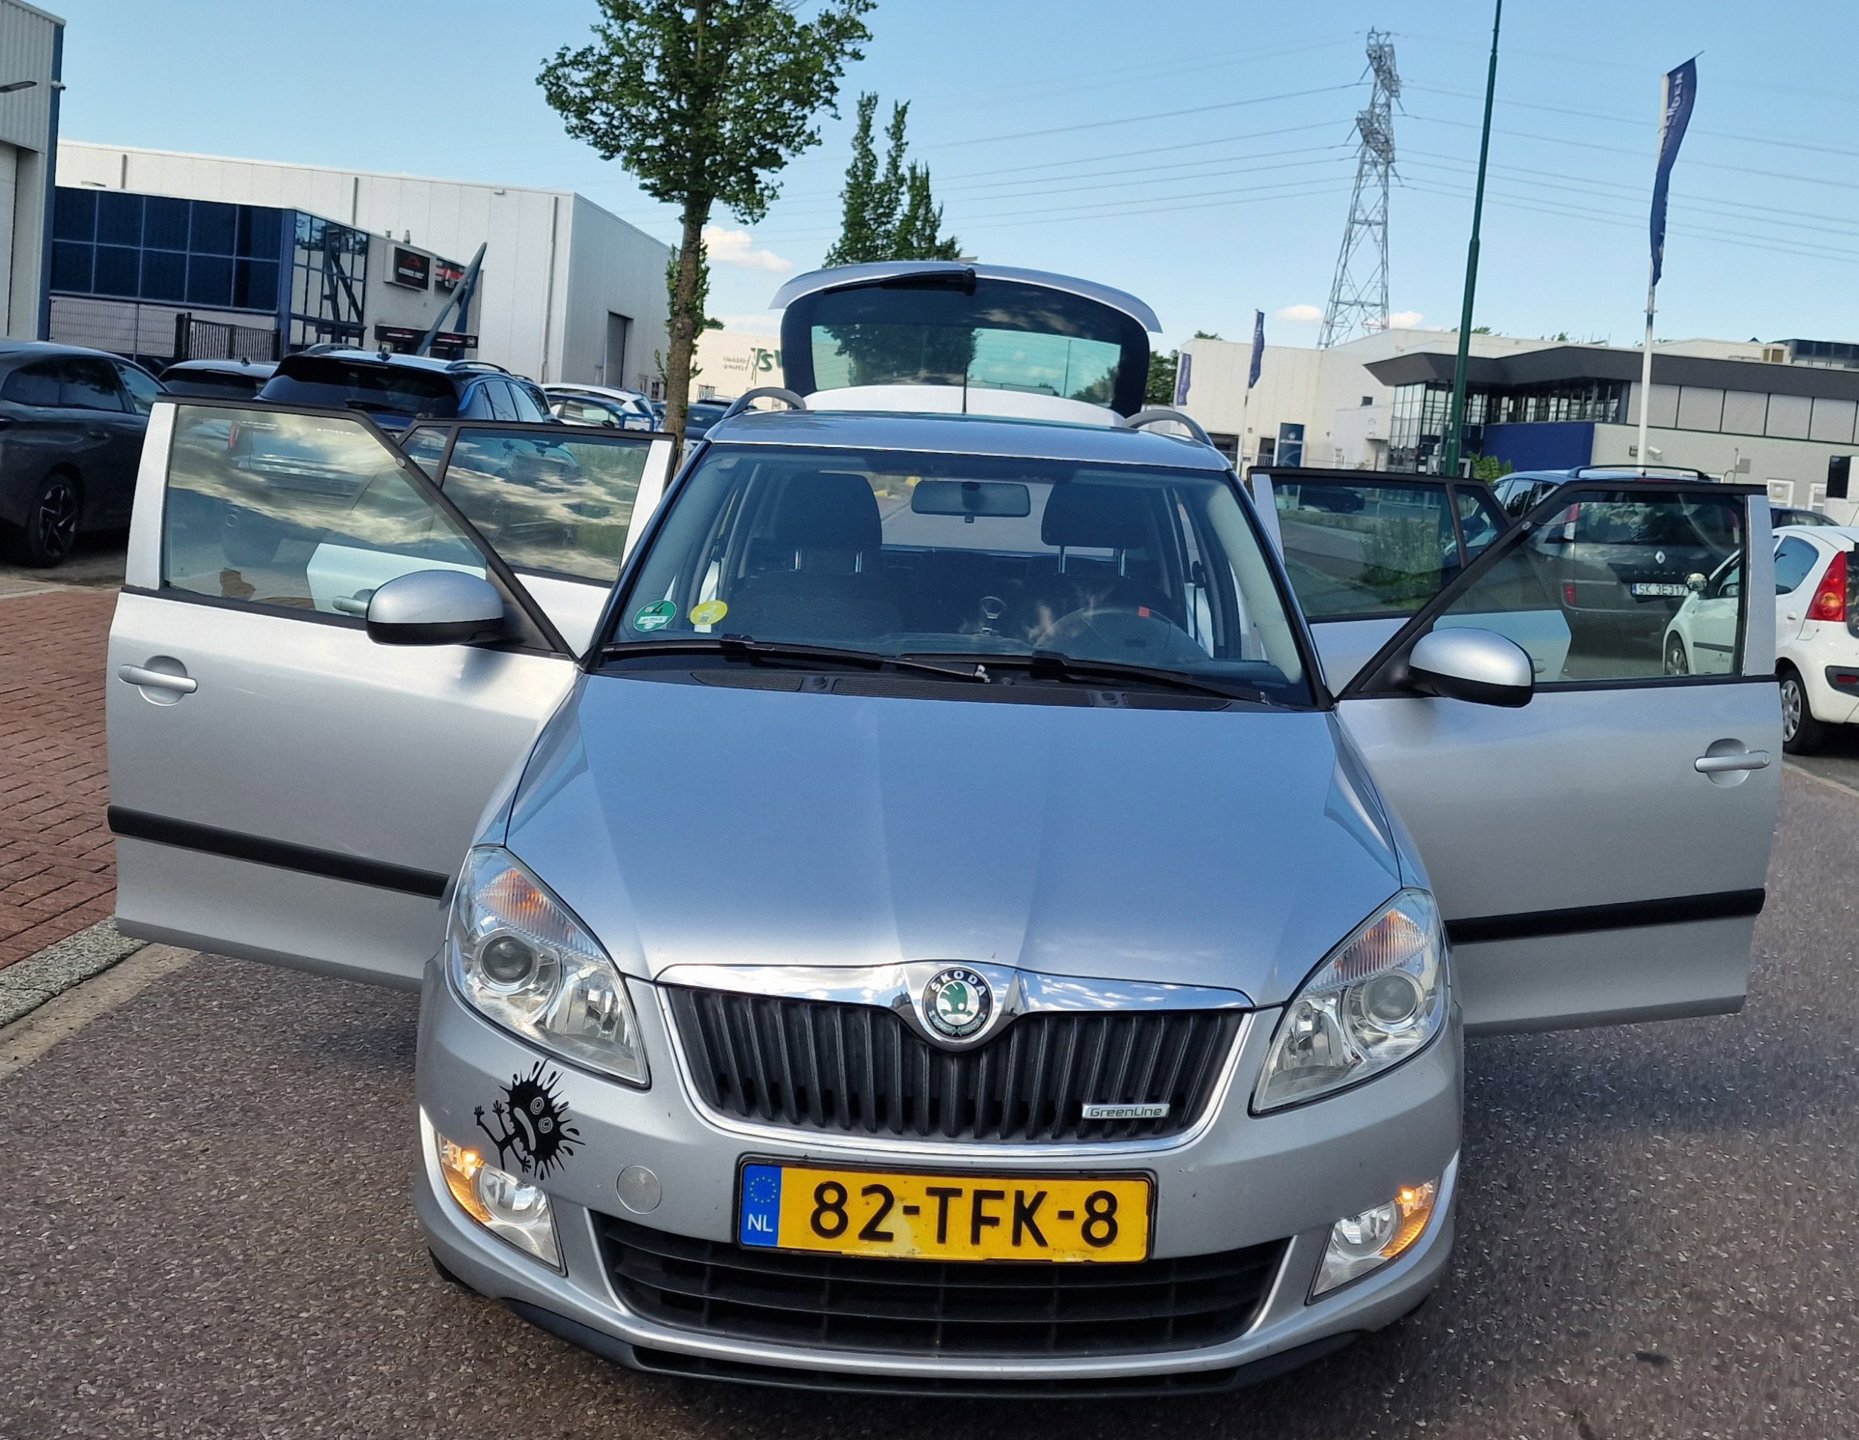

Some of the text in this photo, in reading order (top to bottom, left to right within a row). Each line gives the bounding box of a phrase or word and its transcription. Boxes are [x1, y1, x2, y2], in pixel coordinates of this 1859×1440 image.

[651, 602, 664, 615] 4
[748, 1213, 773, 1232] NL
[810, 1181, 1118, 1248] 82-TFK-8
